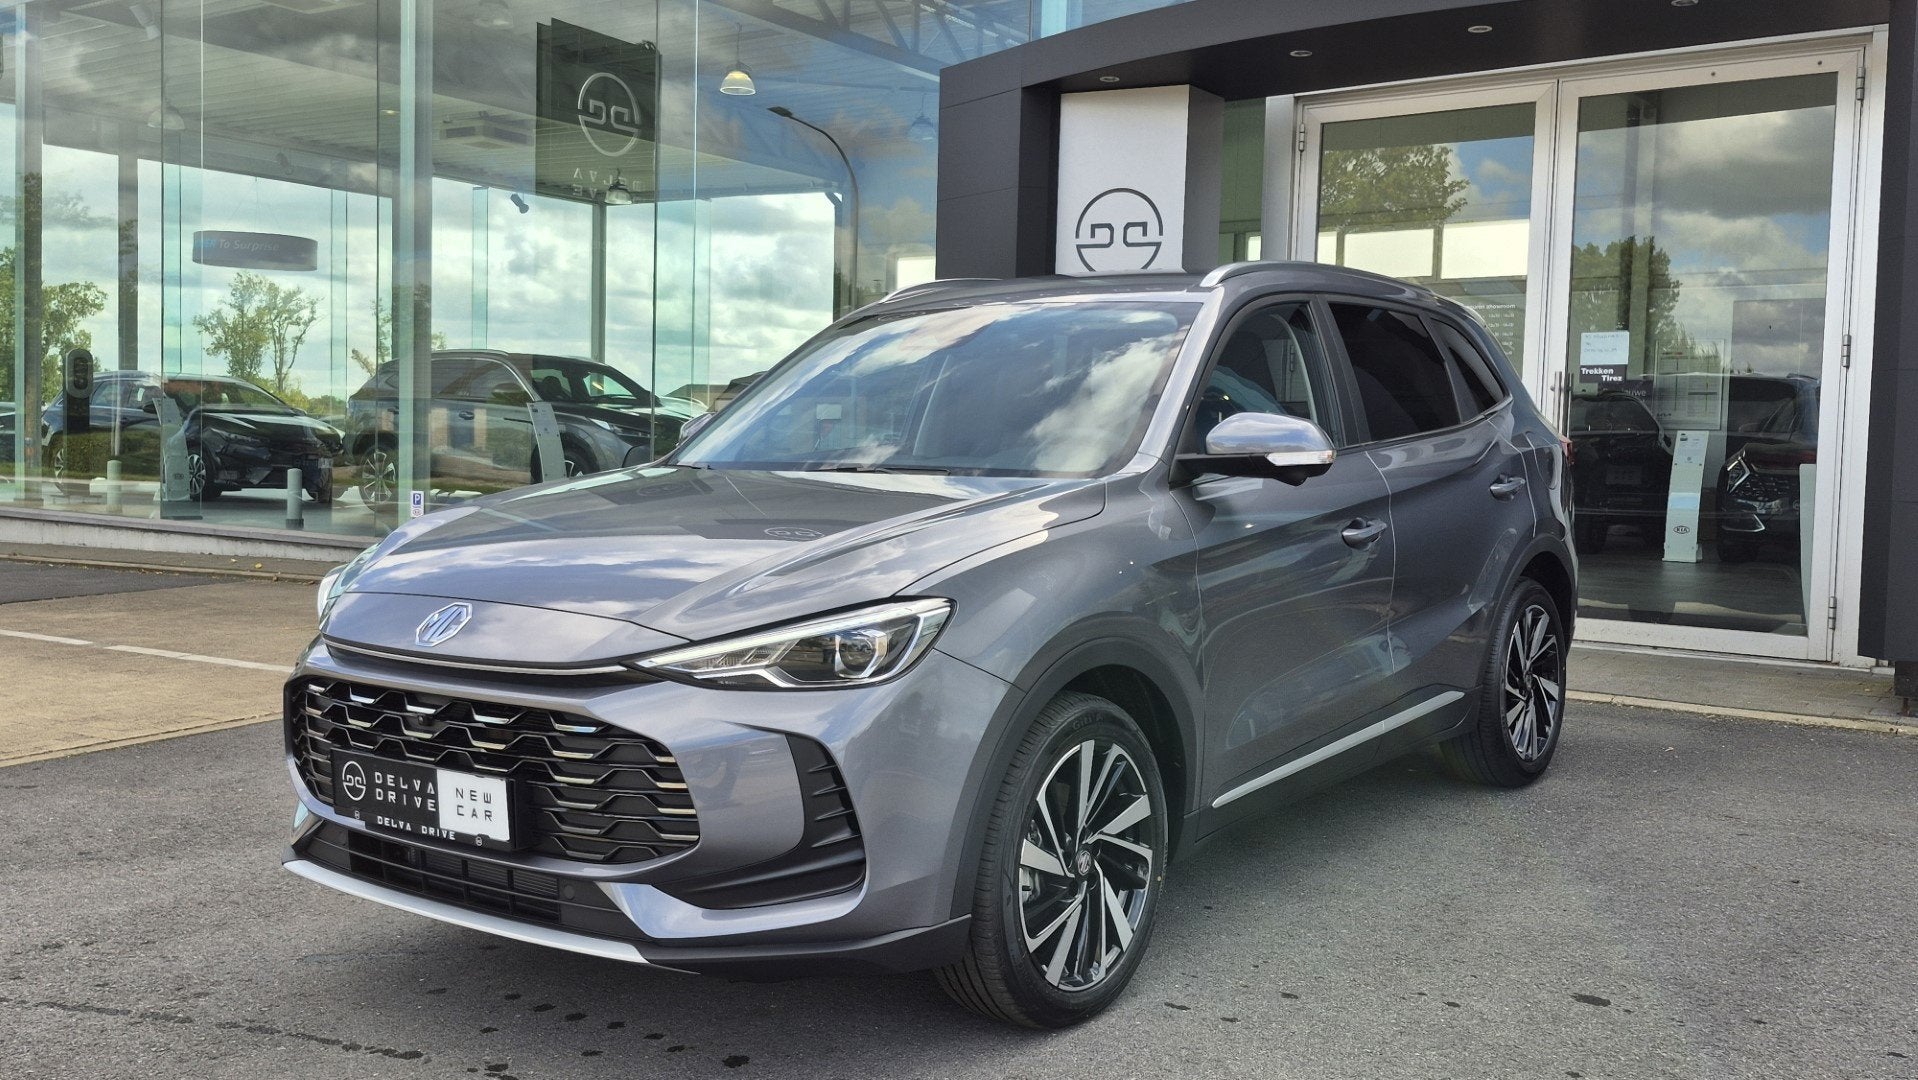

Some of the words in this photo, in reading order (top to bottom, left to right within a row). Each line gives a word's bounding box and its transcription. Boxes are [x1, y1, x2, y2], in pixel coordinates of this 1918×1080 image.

[219, 239, 231, 249] To
[233, 240, 281, 252] Surprise
[1580, 367, 1614, 375] Trekken
[1601, 374, 1623, 382] Tirez
[418, 604, 470, 644] MG
[374, 771, 436, 795] DELVA
[375, 788, 437, 812] DRIVE
[455, 787, 493, 804] NEW
[456, 804, 493, 822] CAR
[376, 815, 413, 831] DELVA
[421, 825, 457, 841] DRIVE
